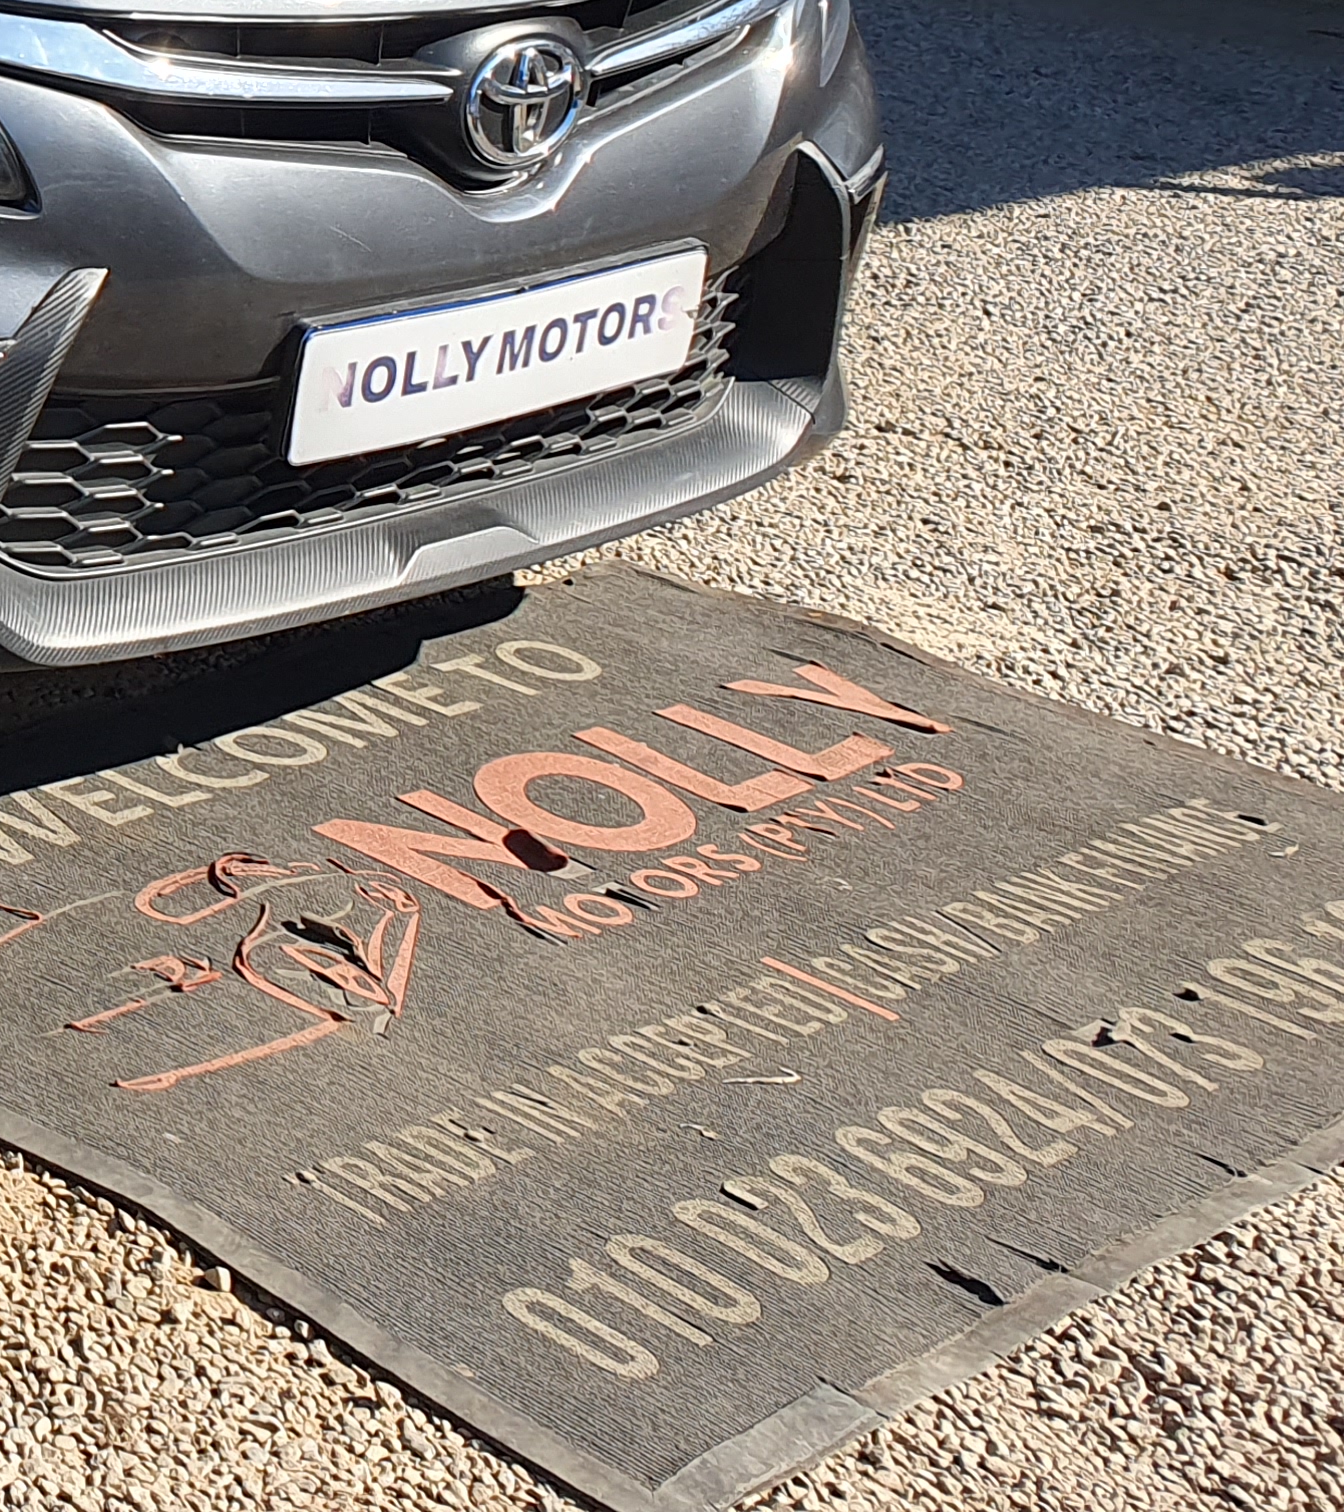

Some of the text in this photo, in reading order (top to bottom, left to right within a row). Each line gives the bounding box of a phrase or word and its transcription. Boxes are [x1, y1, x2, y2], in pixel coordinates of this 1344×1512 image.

[320, 286, 686, 414] NOLLY MOTORS
[312, 662, 955, 910] NOLLY
[429, 640, 603, 696] TO
[281, 1105, 536, 1231] TRADE
[473, 1082, 597, 1143] IN
[1057, 797, 1285, 892] FINANCE
[502, 1233, 762, 1380] 010
[673, 1154, 921, 1286] 023
[834, 1006, 1265, 1207] 6924/073
